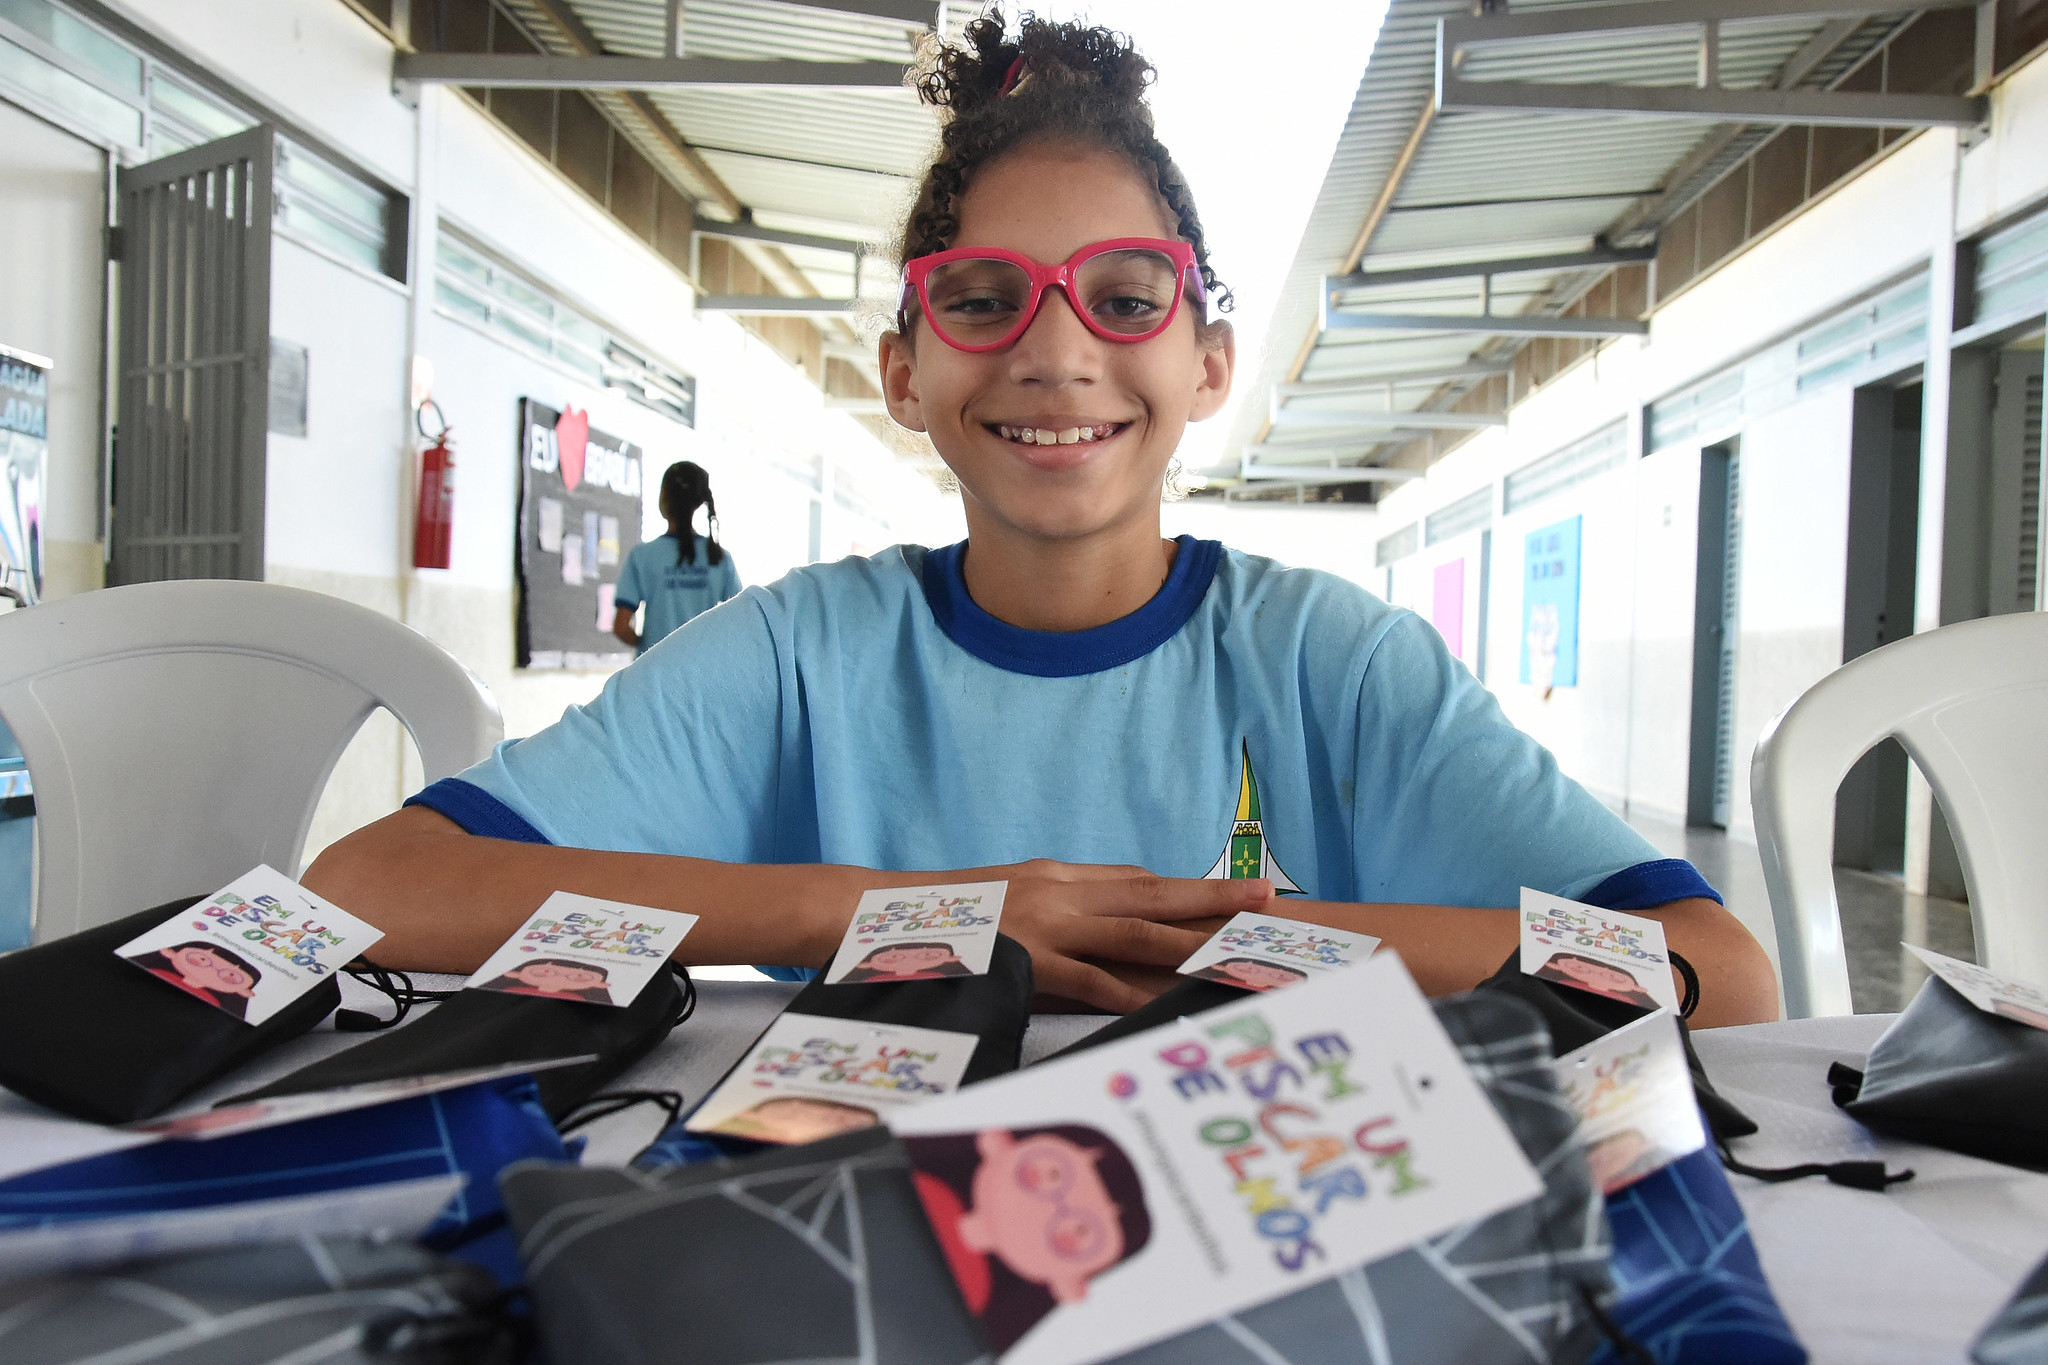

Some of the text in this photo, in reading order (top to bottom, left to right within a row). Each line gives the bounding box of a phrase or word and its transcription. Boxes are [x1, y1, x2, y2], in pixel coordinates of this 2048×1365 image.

[530, 423, 559, 473] EU
[856, 906, 974, 925] PISCAR
[884, 895, 983, 911] EM UM
[213, 893, 326, 956] PISCAR
[253, 895, 346, 946] EM UM
[528, 918, 651, 946] PISCAR
[564, 912, 666, 935] EM UM
[857, 915, 994, 934] DE OLHOS
[1526, 911, 1640, 949] PISCAR
[1549, 908, 1643, 938] EM UM
[202, 906, 330, 975] DE OLHOS
[524, 931, 665, 958] DE OLHOS
[1220, 936, 1258, 947] DE
[1265, 945, 1356, 966] OLHOS
[1222, 928, 1341, 957] PISCAR
[1254, 925, 1351, 949] EM UM
[1530, 923, 1565, 939] DE
[1575, 936, 1665, 964] OLHOS
[1205, 1012, 1367, 1215] PISCAR
[1295, 1030, 1432, 1197] EM UM
[1157, 1041, 1228, 1101] DE
[1199, 1116, 1328, 1272] OLHOS
